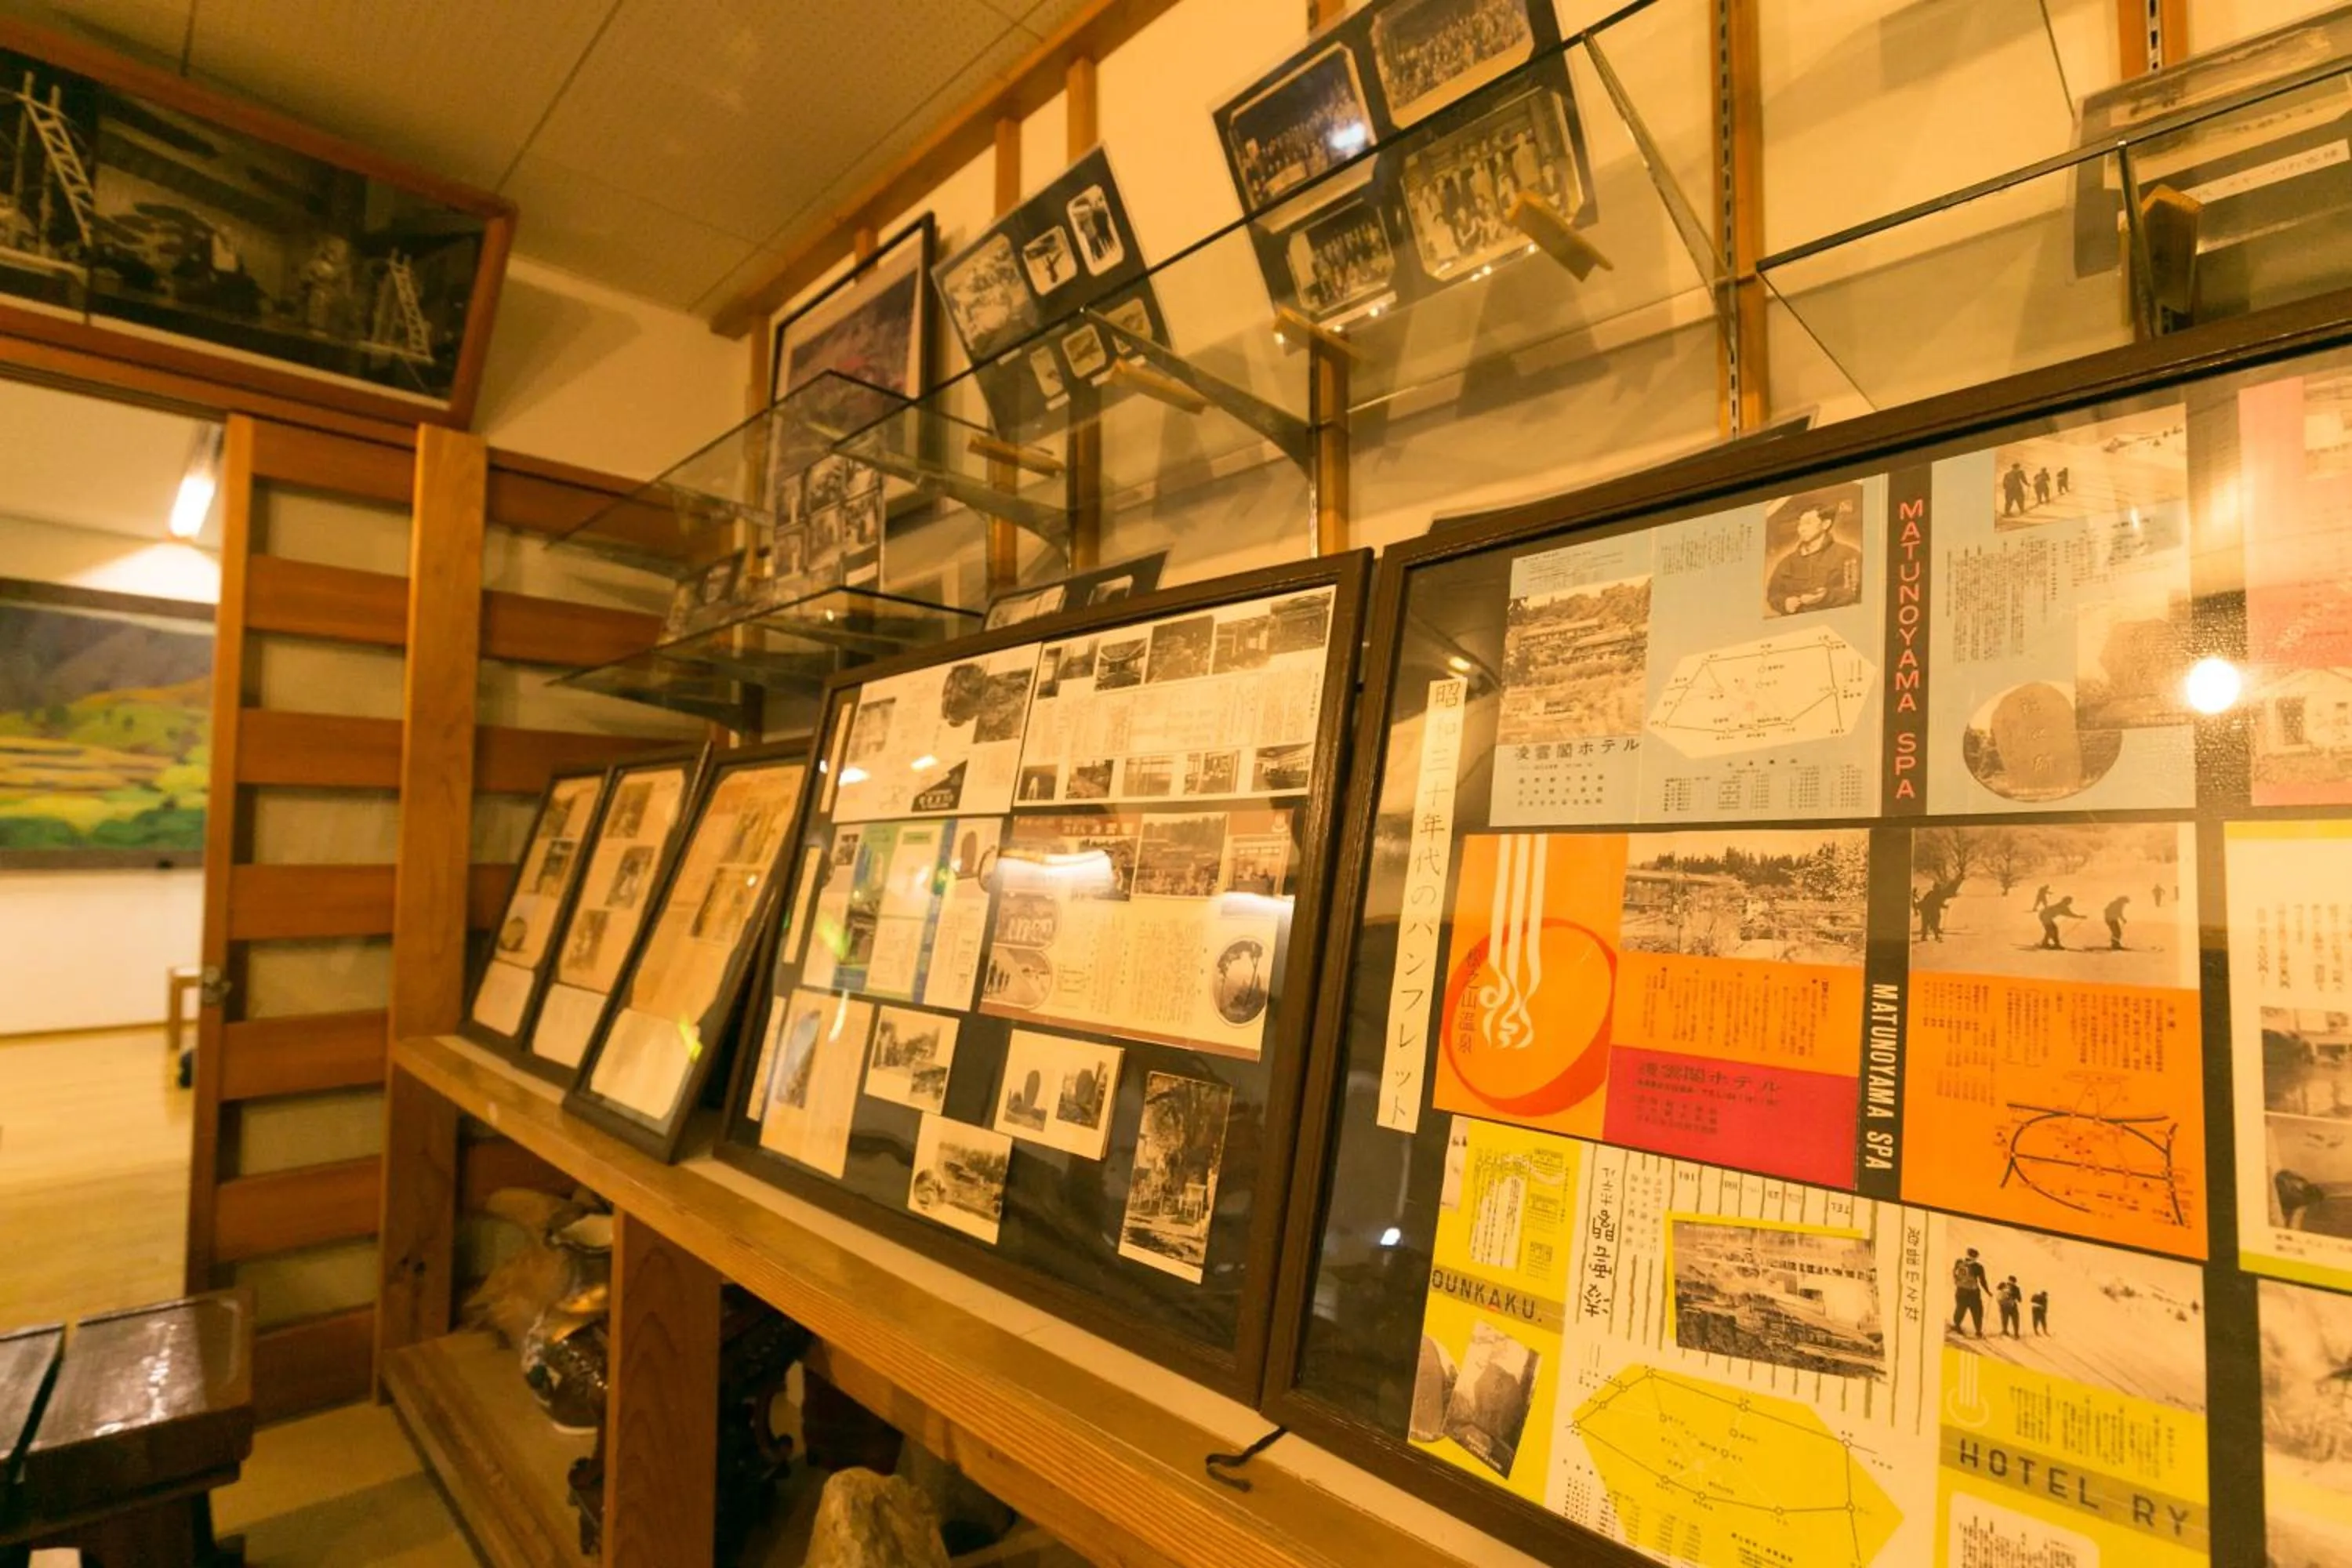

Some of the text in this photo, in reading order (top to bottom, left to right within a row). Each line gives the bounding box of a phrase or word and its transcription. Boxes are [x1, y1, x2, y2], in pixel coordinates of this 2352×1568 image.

[1895, 499, 1923, 799] MATUNOYAMA SPA
[1391, 681, 1461, 1124] 昭和三十年代のパンフレット
[1865, 984, 1898, 1169] MATUNOYAMA SPA
[1960, 1438, 2189, 1536] HOTEL RY
